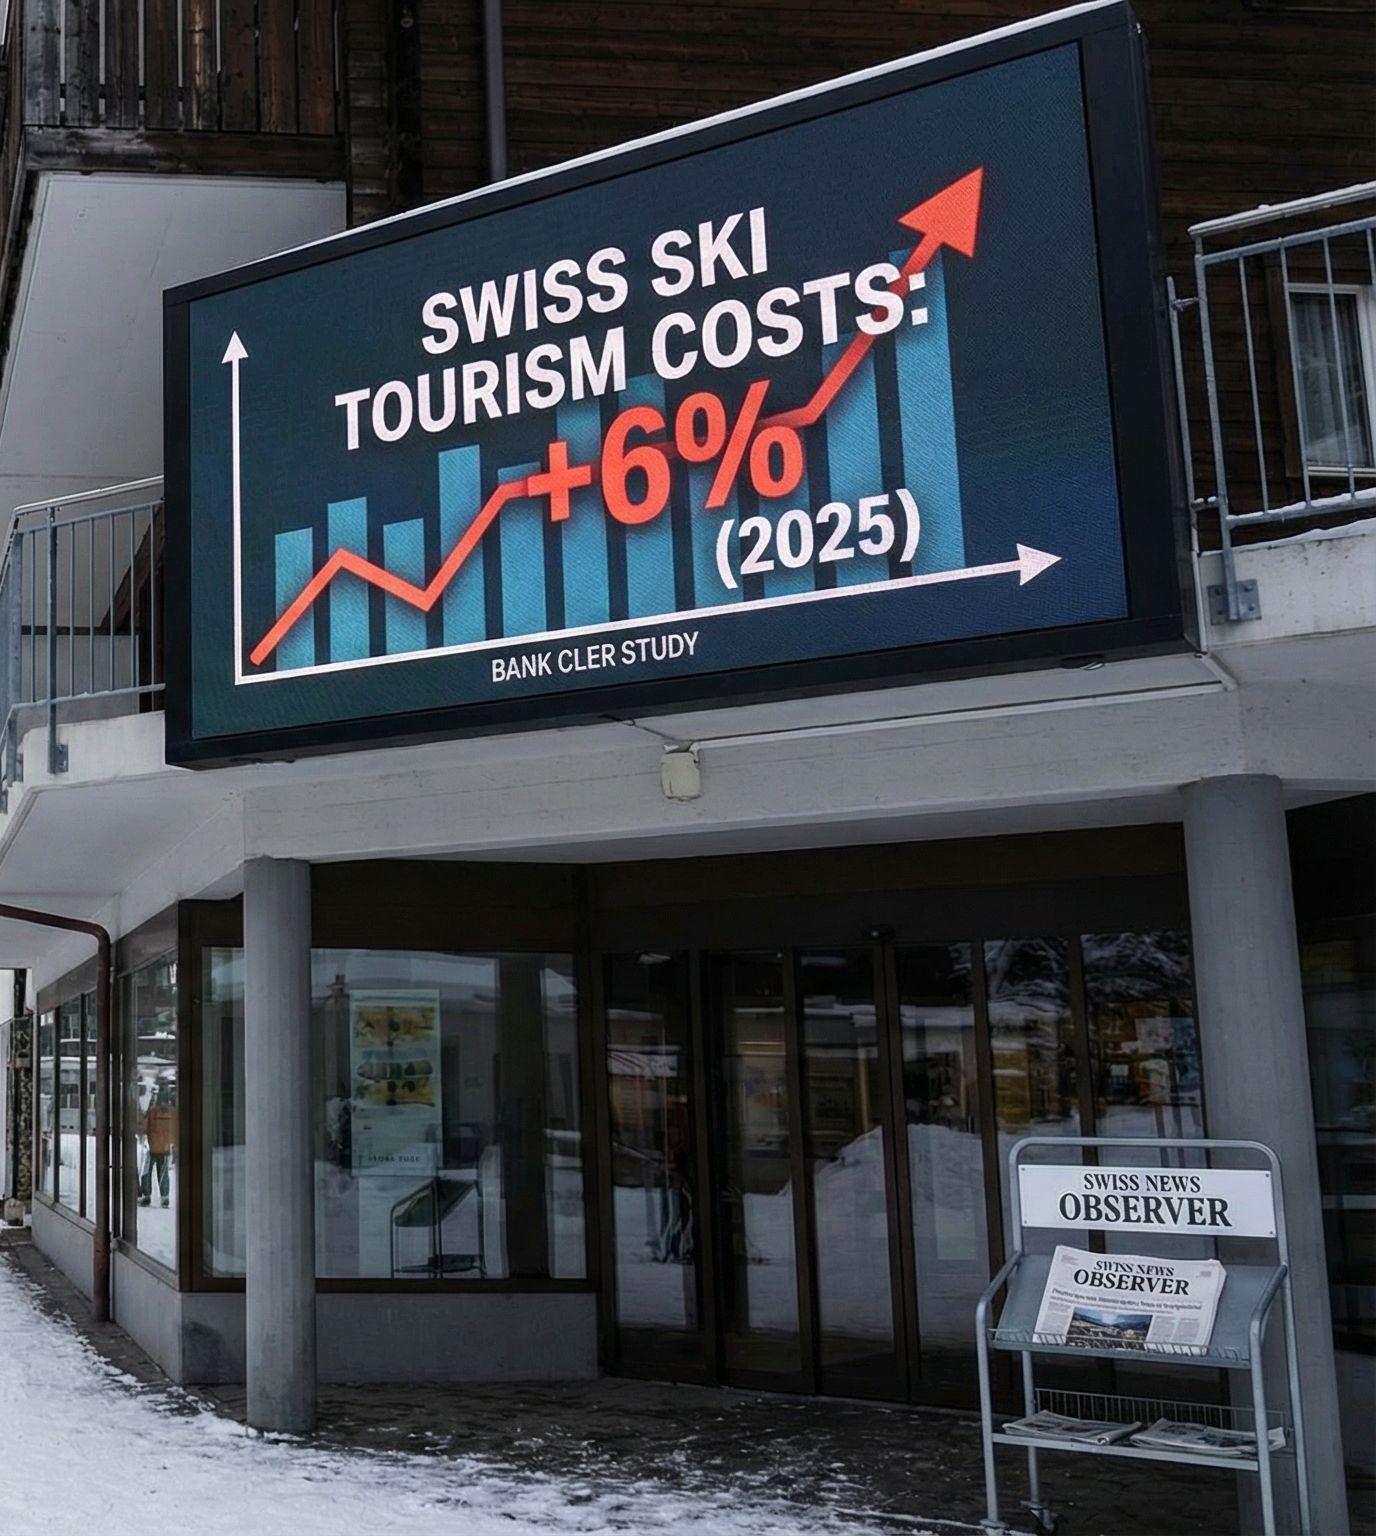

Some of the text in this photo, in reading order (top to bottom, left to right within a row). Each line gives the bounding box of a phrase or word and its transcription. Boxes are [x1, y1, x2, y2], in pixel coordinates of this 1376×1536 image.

[421, 206, 768, 356] SWISS SKI
[334, 261, 929, 451] TOURISM COSTS:
[527, 380, 806, 526] +6%
[715, 488, 920, 589] (2025)
[491, 631, 699, 683] BANK CLER STUDY
[1059, 1193, 1232, 1227] OBSERVER
[1084, 1173, 1201, 1193] SWISS NEWS
[1074, 1269, 1189, 1296] OBSERVER
